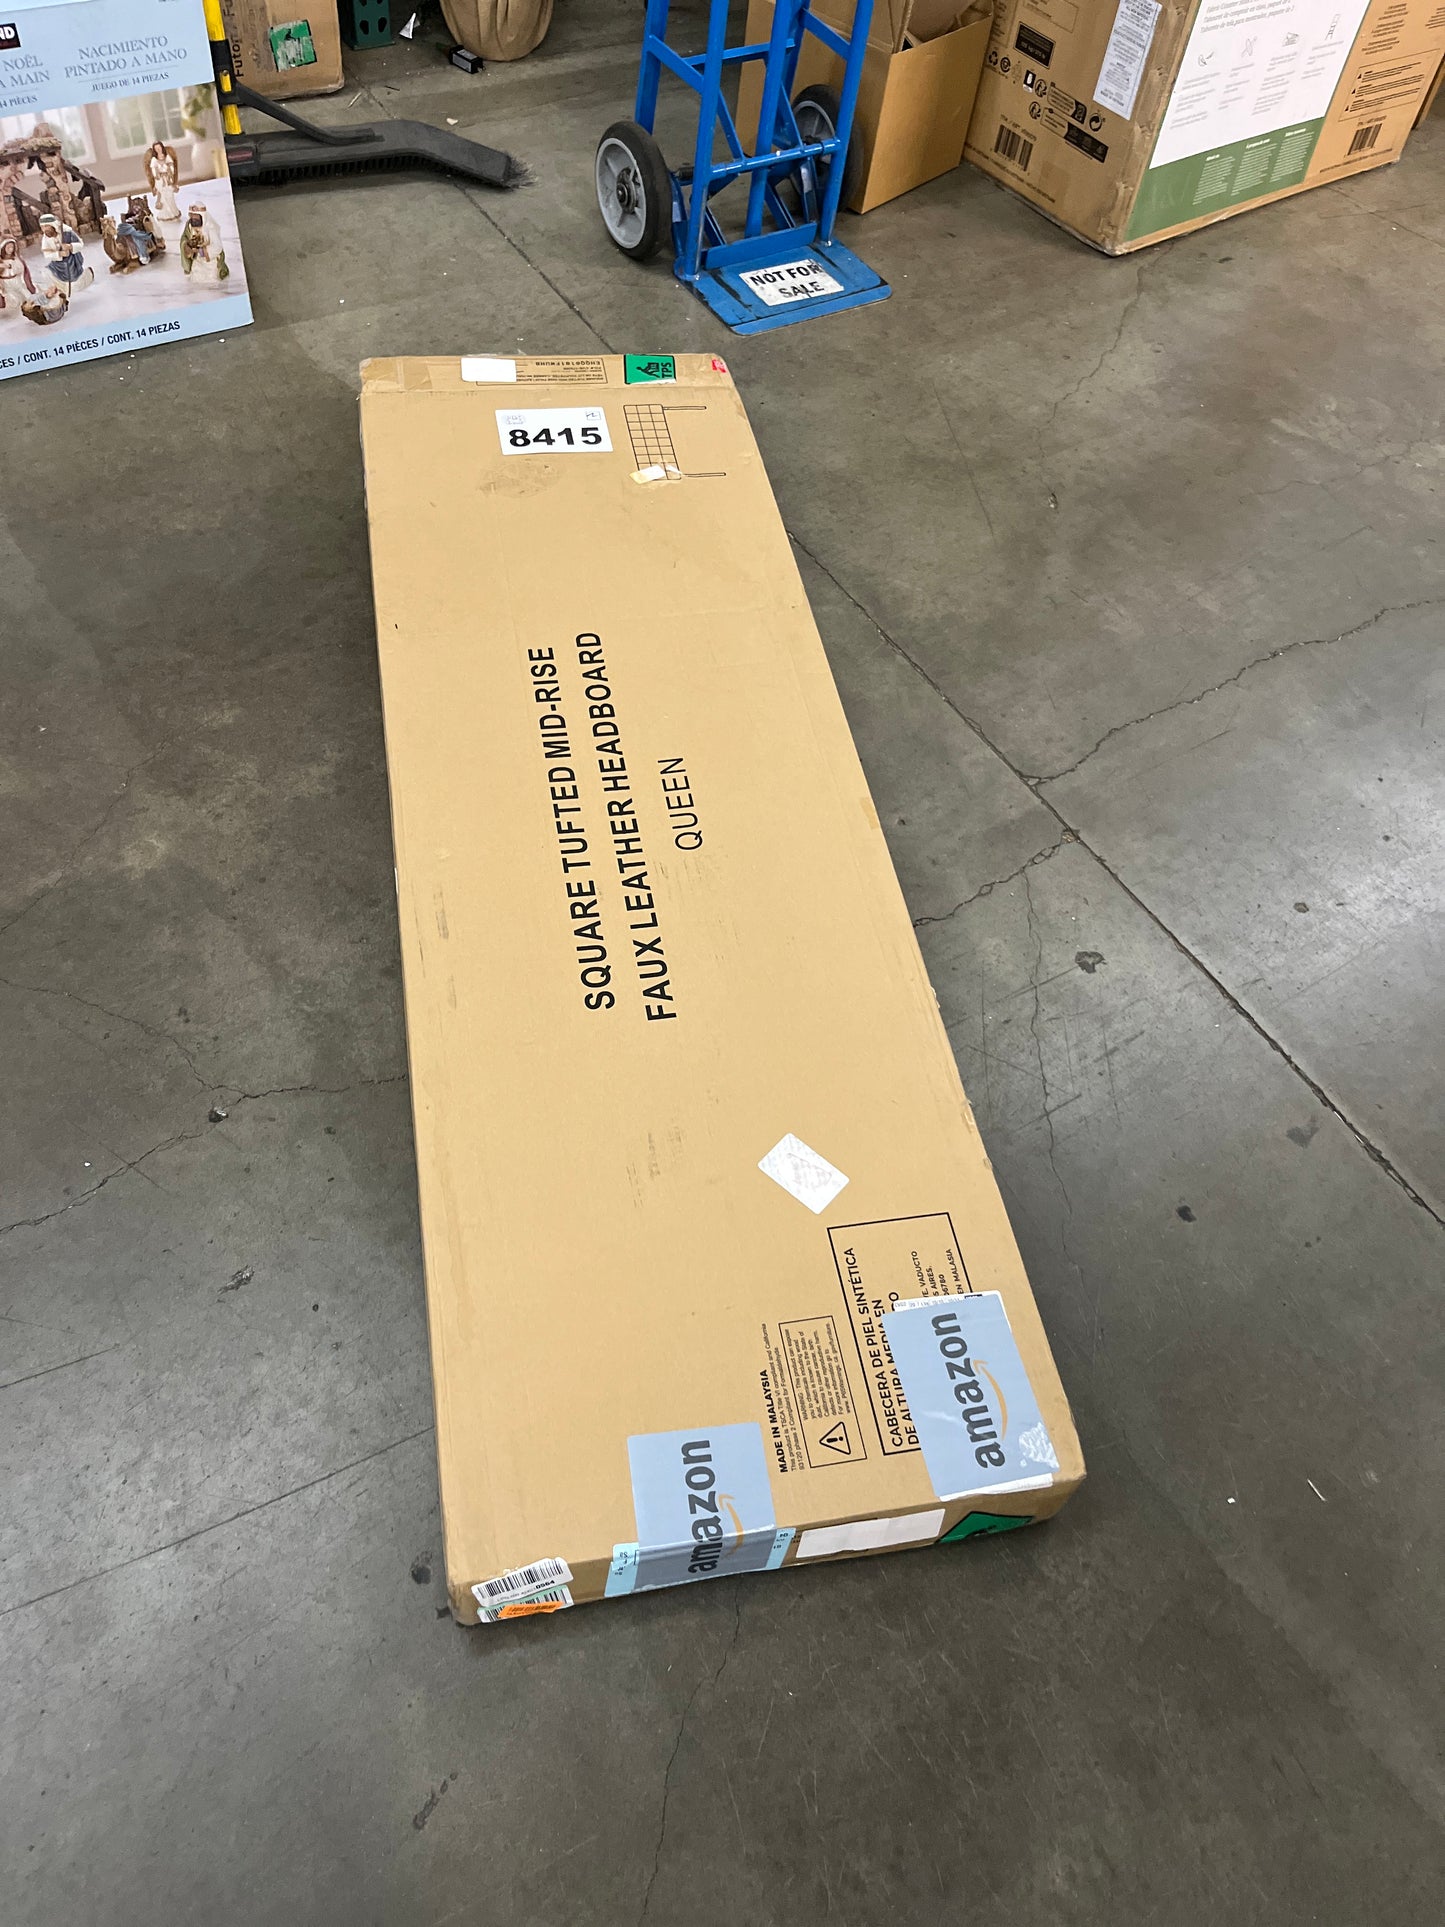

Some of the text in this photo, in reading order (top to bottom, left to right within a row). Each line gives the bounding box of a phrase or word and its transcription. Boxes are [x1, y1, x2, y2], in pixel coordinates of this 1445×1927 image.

[78, 35, 168, 60] NACIMIENTO
[64, 47, 188, 79] PINTADO A MANO
[10, 70, 50, 87] MAIN
[91, 72, 170, 92] JUEGO DE 14 PIEZAS
[9, 94, 38, 107] PIÈCES
[749, 263, 822, 286] NOT FOR
[778, 281, 825, 298] SALE
[23, 349, 52, 365] CONT.
[53, 346, 65, 356] 14
[66, 338, 99, 354] PIÈCES
[107, 331, 135, 345] CONT.
[136, 328, 147, 338] 14
[148, 320, 181, 336] PIEZAS
[661, 362, 672, 378] TPS
[509, 427, 602, 447] 8415
[657, 757, 704, 850] QUEEN
[528, 647, 615, 1010] SQUARE TUFTED MID-RISE
[575, 632, 677, 1021] FAUX LEATHER HEADBOARD
[945, 1248, 960, 1281] MALASIA
[872, 1299, 885, 1317] EN
[844, 1248, 903, 1446] CABECERA DE PIEL SINTÉTICA
[931, 1312, 1005, 1468] amazon
[759, 1369, 788, 1473] MADE IN MALAYSIA
[905, 1425, 919, 1445] DE
[680, 1440, 724, 1574] amazon
